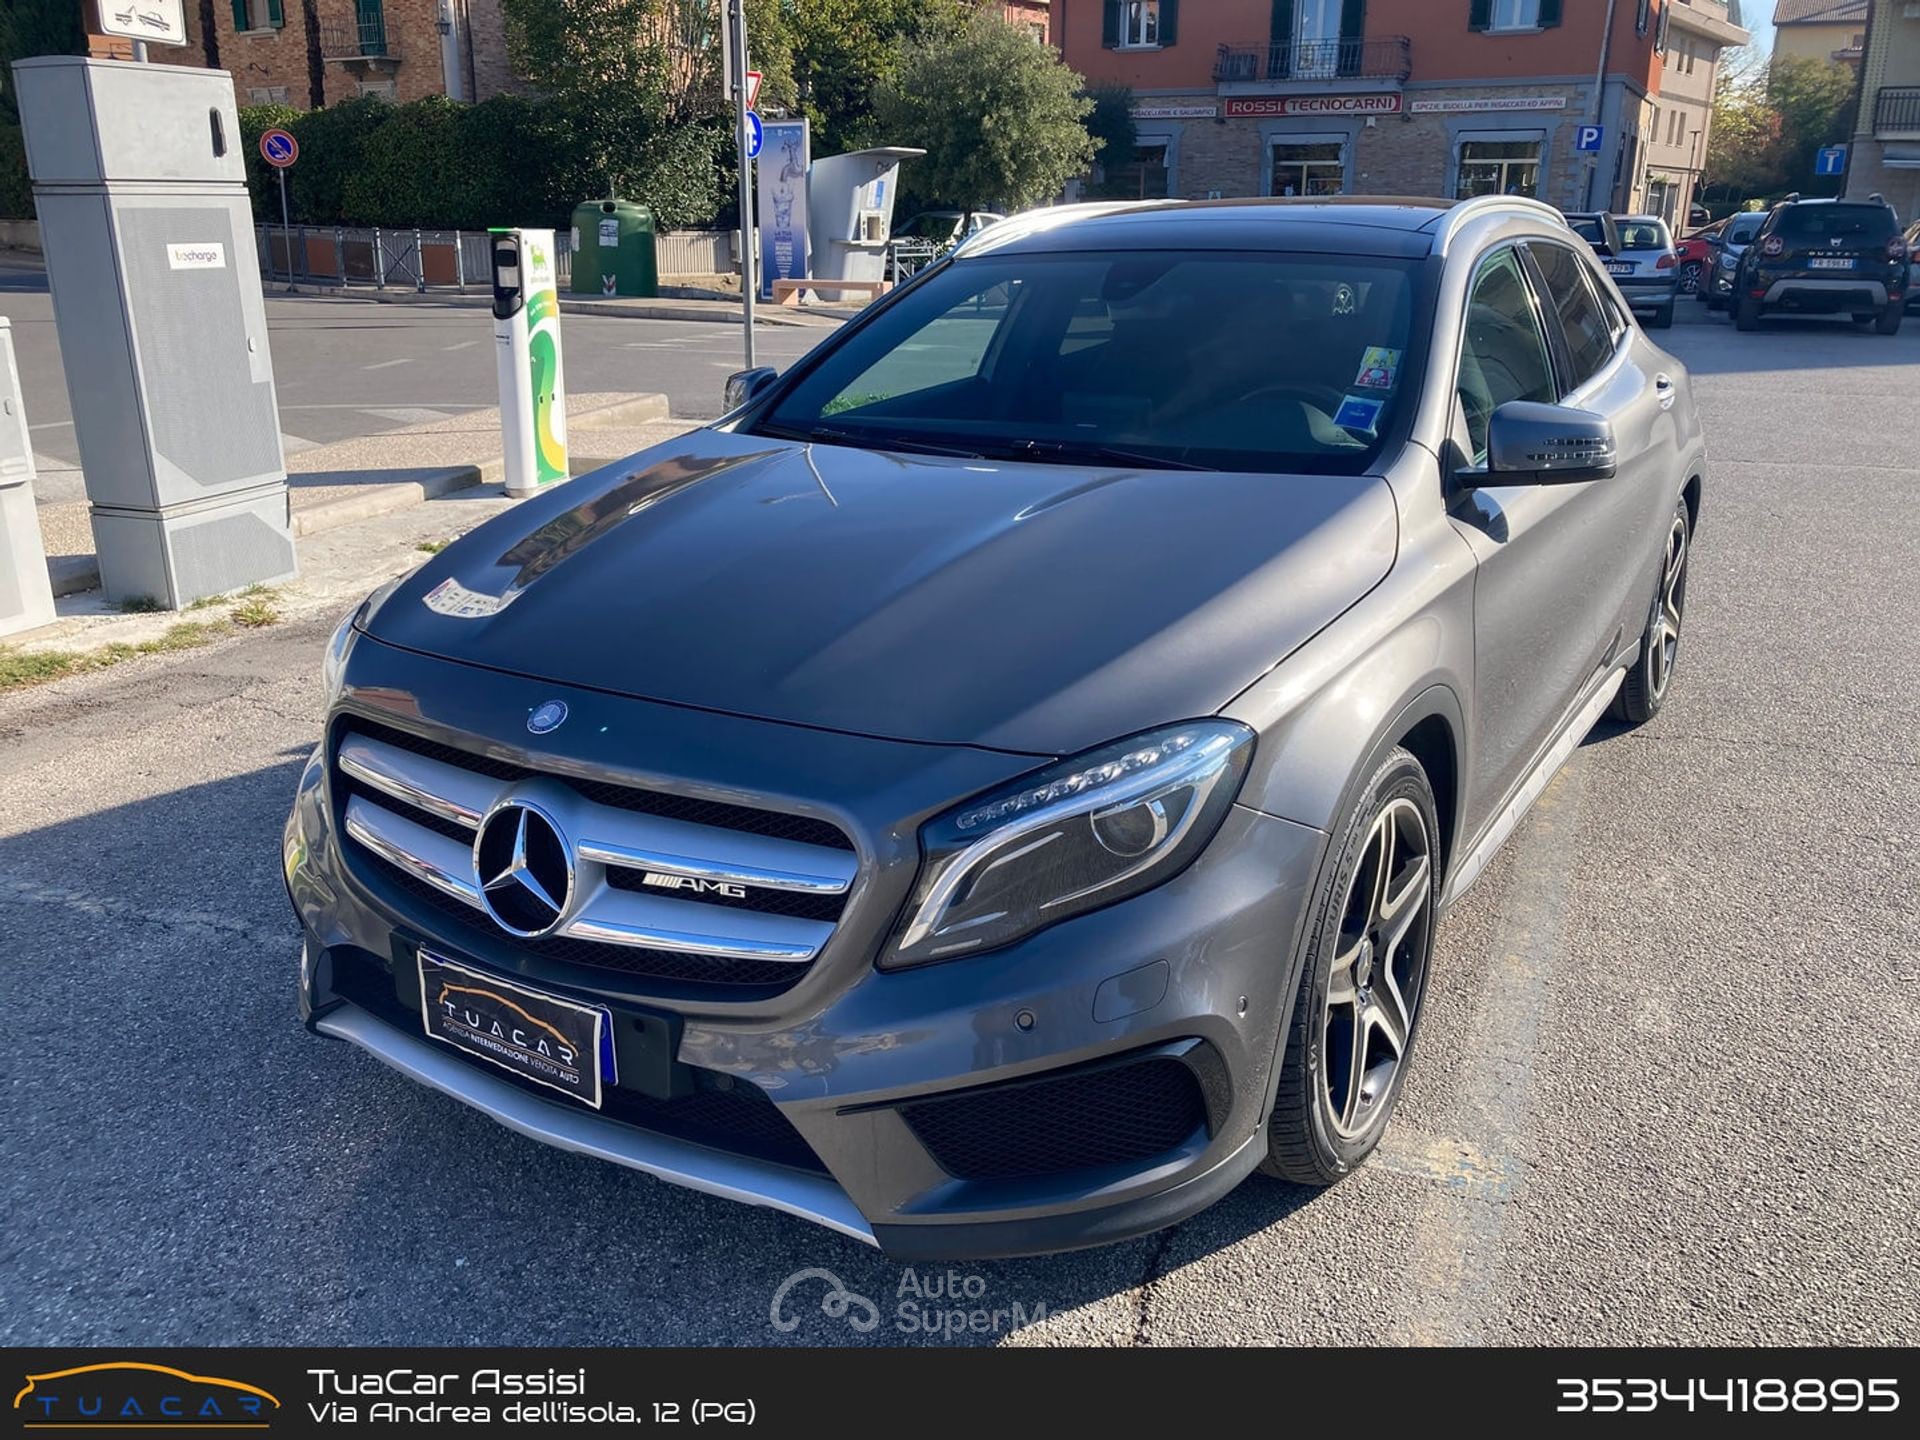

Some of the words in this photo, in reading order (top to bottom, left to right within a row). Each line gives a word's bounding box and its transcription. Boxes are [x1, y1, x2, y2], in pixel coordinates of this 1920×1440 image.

[1231, 101, 1281, 112] ROSSI
[1290, 97, 1392, 111] TECNOCARNI
[1581, 127, 1599, 149] P
[679, 877, 746, 898] AMG
[444, 1000, 573, 1066] TUACAR
